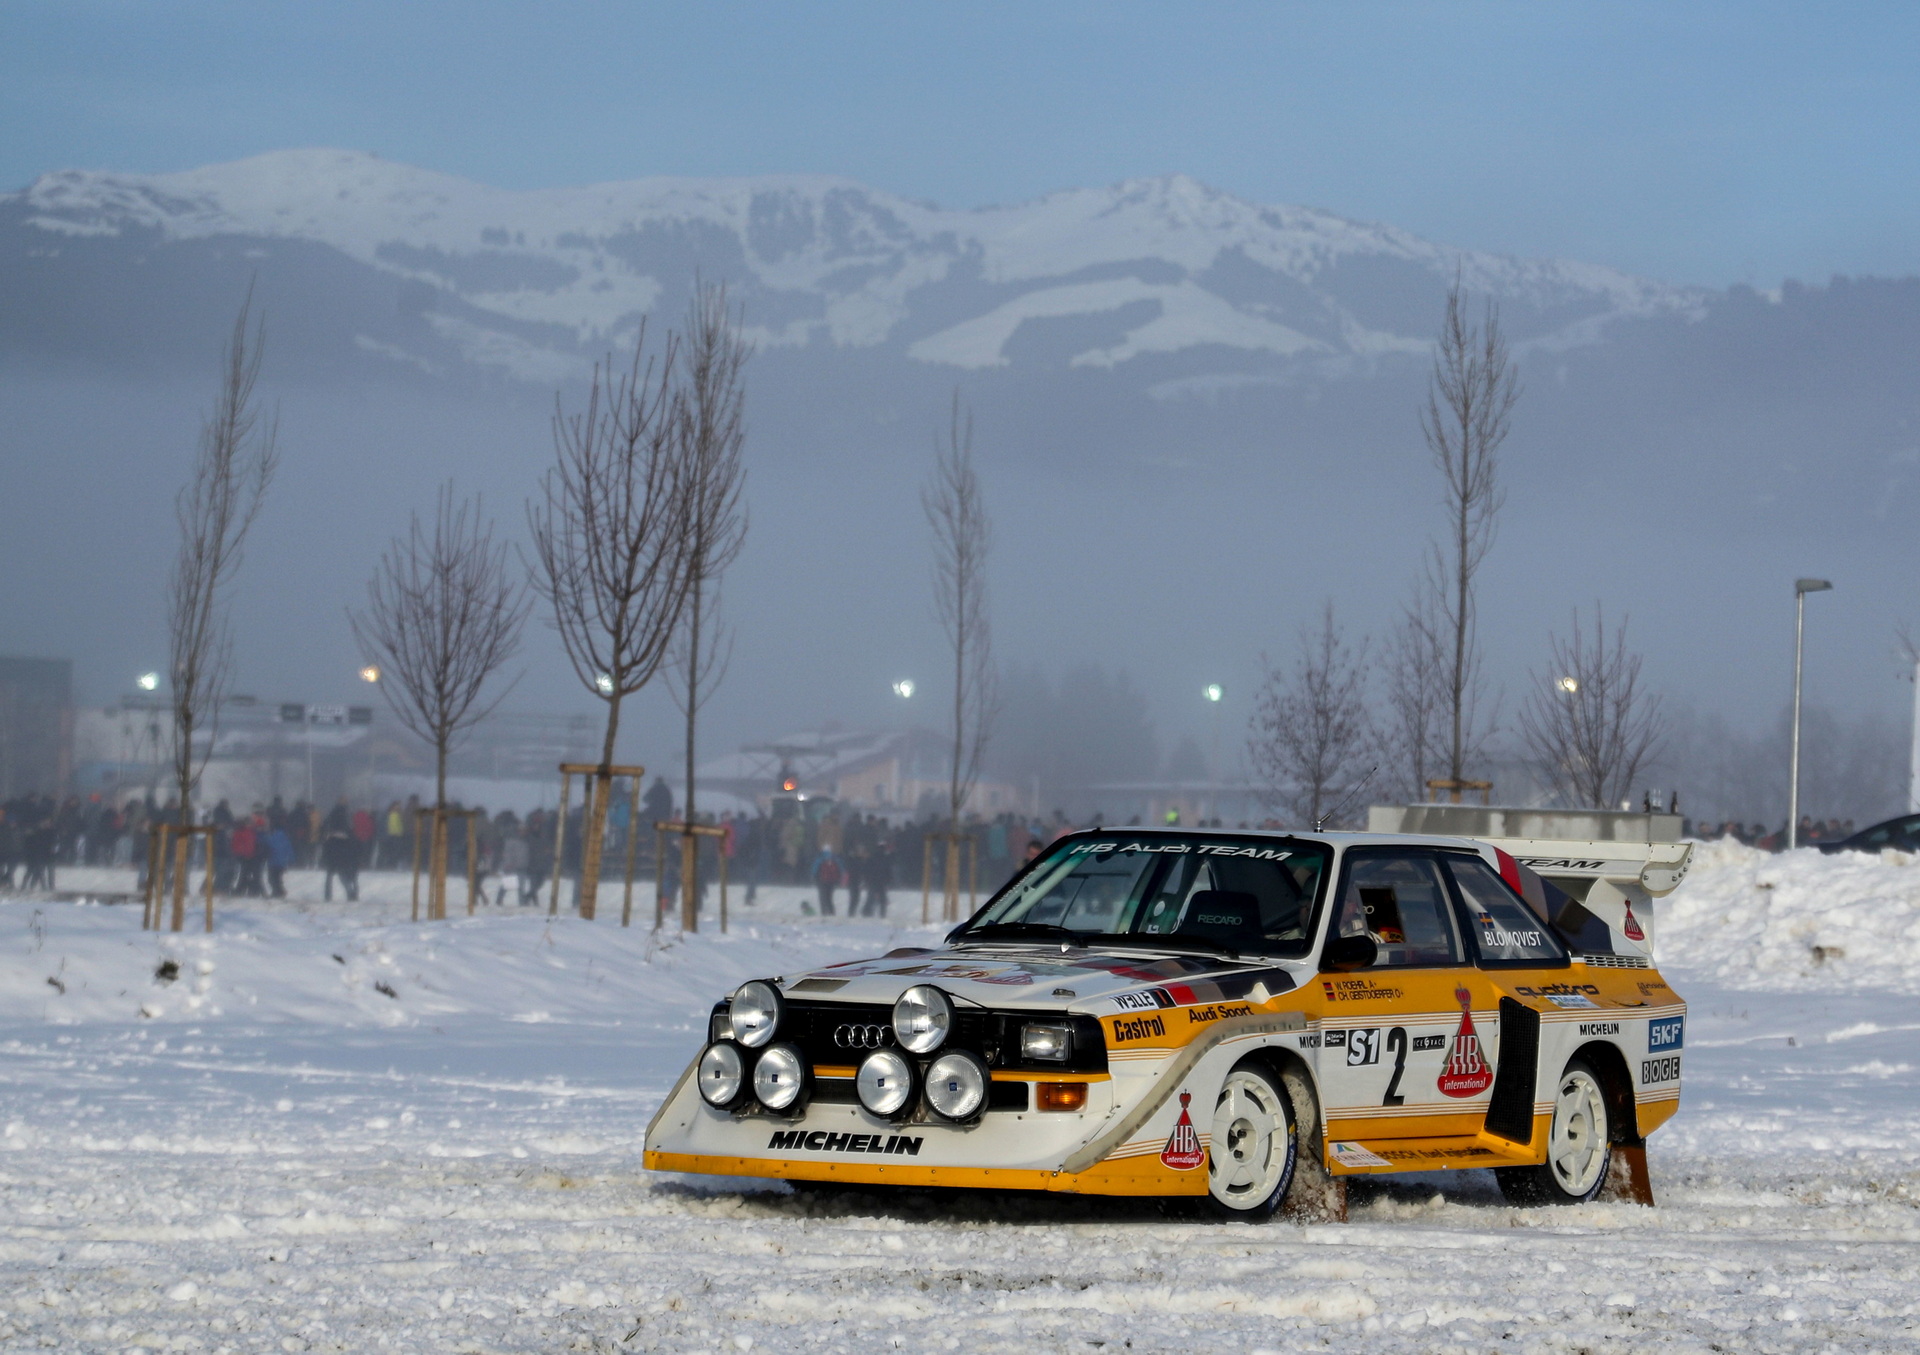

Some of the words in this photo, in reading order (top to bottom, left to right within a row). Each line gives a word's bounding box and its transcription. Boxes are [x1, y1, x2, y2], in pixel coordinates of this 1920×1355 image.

[1069, 843, 1117, 855] HB
[1197, 844, 1293, 861] TEAM
[1198, 914, 1242, 926] RECARO
[1484, 931, 1542, 948] BLOMQVIST
[1349, 989, 1394, 1000] GEISTDOERFER
[1515, 983, 1600, 999] quattro
[1189, 1006, 1218, 1023] Audi
[1221, 1005, 1254, 1019] Sport
[1113, 1015, 1166, 1042] Castrol
[1580, 1023, 1619, 1036] MICHELIN
[1651, 1023, 1681, 1046] SKF
[1348, 1029, 1379, 1065] S1
[1452, 1035, 1481, 1075] HB
[1382, 1026, 1408, 1106] 2
[1642, 1057, 1680, 1084] BOGE
[1444, 1077, 1486, 1091] international
[767, 1130, 924, 1156] MICHELIN
[1173, 1125, 1196, 1153] HB
[1166, 1154, 1200, 1164] international
